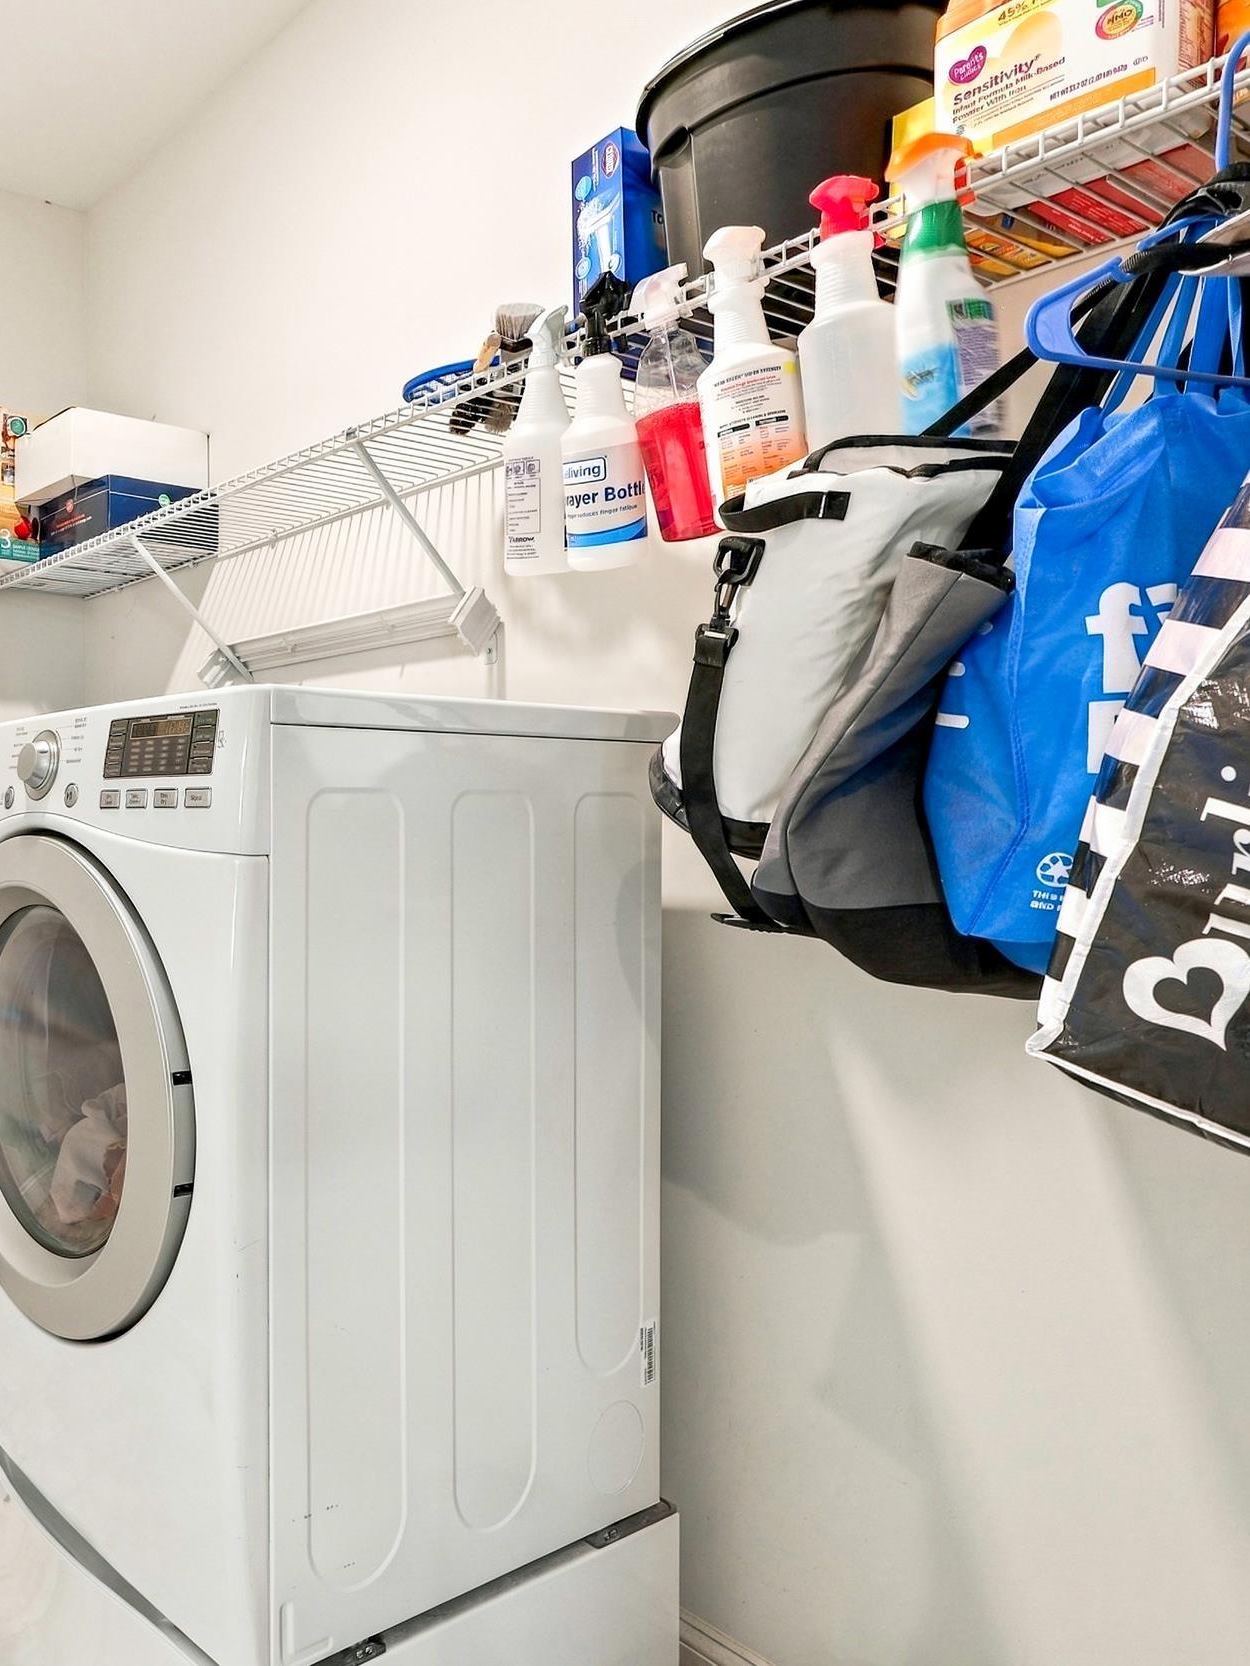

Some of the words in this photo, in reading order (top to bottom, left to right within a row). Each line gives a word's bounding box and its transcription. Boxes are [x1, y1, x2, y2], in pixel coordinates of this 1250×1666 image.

[954, 52, 984, 78] Parent's
[978, 82, 1013, 103] Formula
[1015, 57, 1066, 85] Milk-Based
[952, 105, 984, 124] Powder
